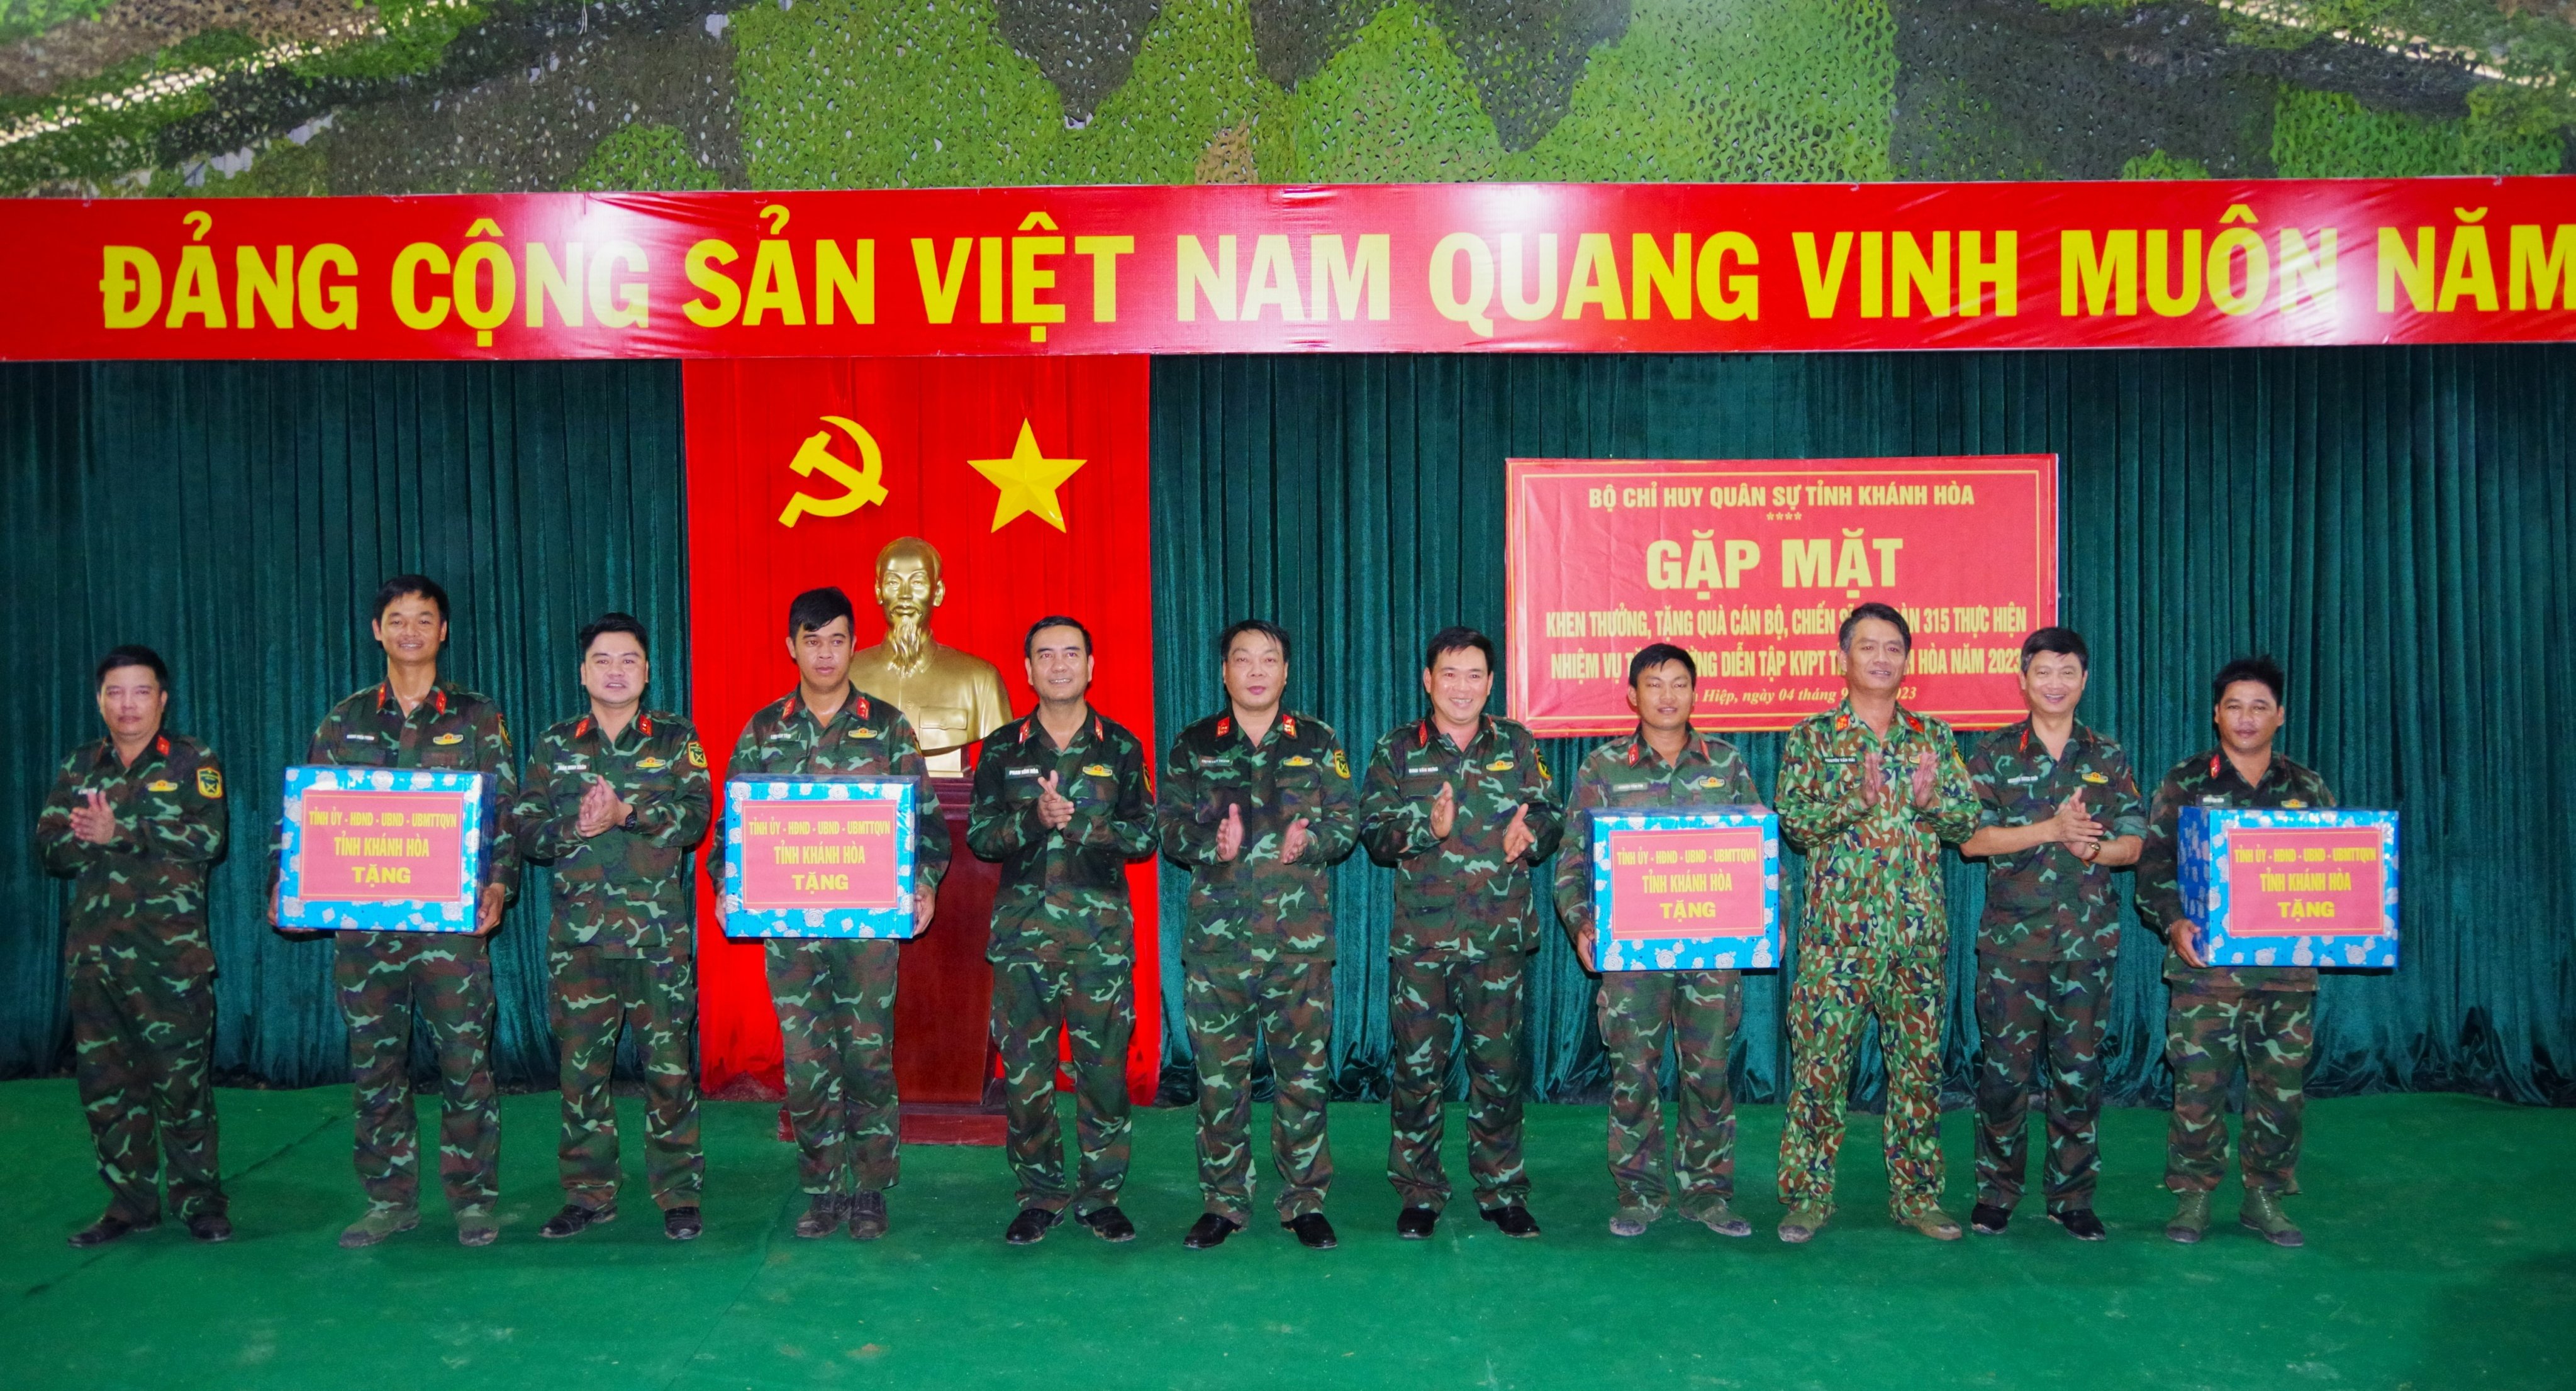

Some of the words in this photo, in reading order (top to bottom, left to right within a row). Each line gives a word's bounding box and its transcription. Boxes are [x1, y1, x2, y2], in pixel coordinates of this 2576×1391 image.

[99, 210, 359, 330] ĐẢNG
[390, 218, 650, 348] CỘNG
[682, 204, 875, 328] SẢN
[910, 211, 1135, 343] VIỆT
[1177, 234, 1391, 322] NAM
[1428, 230, 1759, 338] QUANG
[1792, 230, 2018, 319] VINH
[2060, 204, 2338, 318] MUÔN
[2377, 206, 2576, 313] NĂM
[1589, 484, 1617, 513] BỘ
[1623, 481, 1658, 508] CHỈ
[1663, 486, 1703, 508] HUY
[1710, 482, 1766, 509] QUÂN
[1772, 484, 1802, 511] SỰ
[1805, 479, 1852, 506] TỈNH
[1858, 481, 1927, 506] KHÁNH
[1934, 480, 1975, 506] HÒA
[1646, 529, 1761, 601] GẶP
[1781, 528, 1904, 599] MẶT
[1546, 611, 1586, 638] KHEN
[1589, 602, 1652, 640] THƯỞNG,
[1654, 604, 1693, 641] TẶNG
[1697, 604, 1727, 638] QUÀ
[1731, 604, 1761, 636] CÁN
[1764, 604, 1788, 641] BỘ,
[1792, 601, 1835, 635] CHIẾN
[1923, 607, 1950, 634] 315
[1953, 605, 1990, 638] THỰC
[1993, 602, 2027, 638] HIỆN
[1551, 648, 1599, 684] NHIỆM
[1603, 652, 1622, 684] VỤ
[1721, 641, 1755, 677] DIỄN
[1758, 646, 1787, 682] TẬP
[1790, 650, 1826, 676] KVPT
[1919, 643, 1948, 674] HÒA
[1951, 643, 1985, 674] NĂM
[1988, 648, 2022, 674] 2023
[1702, 689, 1738, 705] Hiệp,
[1742, 689, 1775, 705] ngày
[1779, 689, 1795, 701] 04
[1798, 687, 1837, 704] tháng
[309, 806, 328, 826] TỈNH
[381, 812, 404, 826] UBND
[749, 817, 767, 835] TỈNH
[818, 821, 840, 835] UBND
[334, 831, 360, 856] TỈNH
[364, 833, 403, 856] KHÁNH
[406, 833, 430, 857] HÒA
[774, 840, 800, 865] TỈNH
[803, 841, 840, 864] KHÁNH
[843, 841, 866, 864] HÒA
[1617, 847, 1636, 865] TỈNH
[1685, 850, 1707, 863] UBND
[351, 864, 411, 887] TẶNG
[791, 872, 849, 894] TẶNG
[1642, 868, 1667, 894] TỈNH
[1670, 869, 1707, 892] KHÁNH
[1710, 868, 1732, 891] HÒA
[1660, 900, 1716, 923] TẶNG
